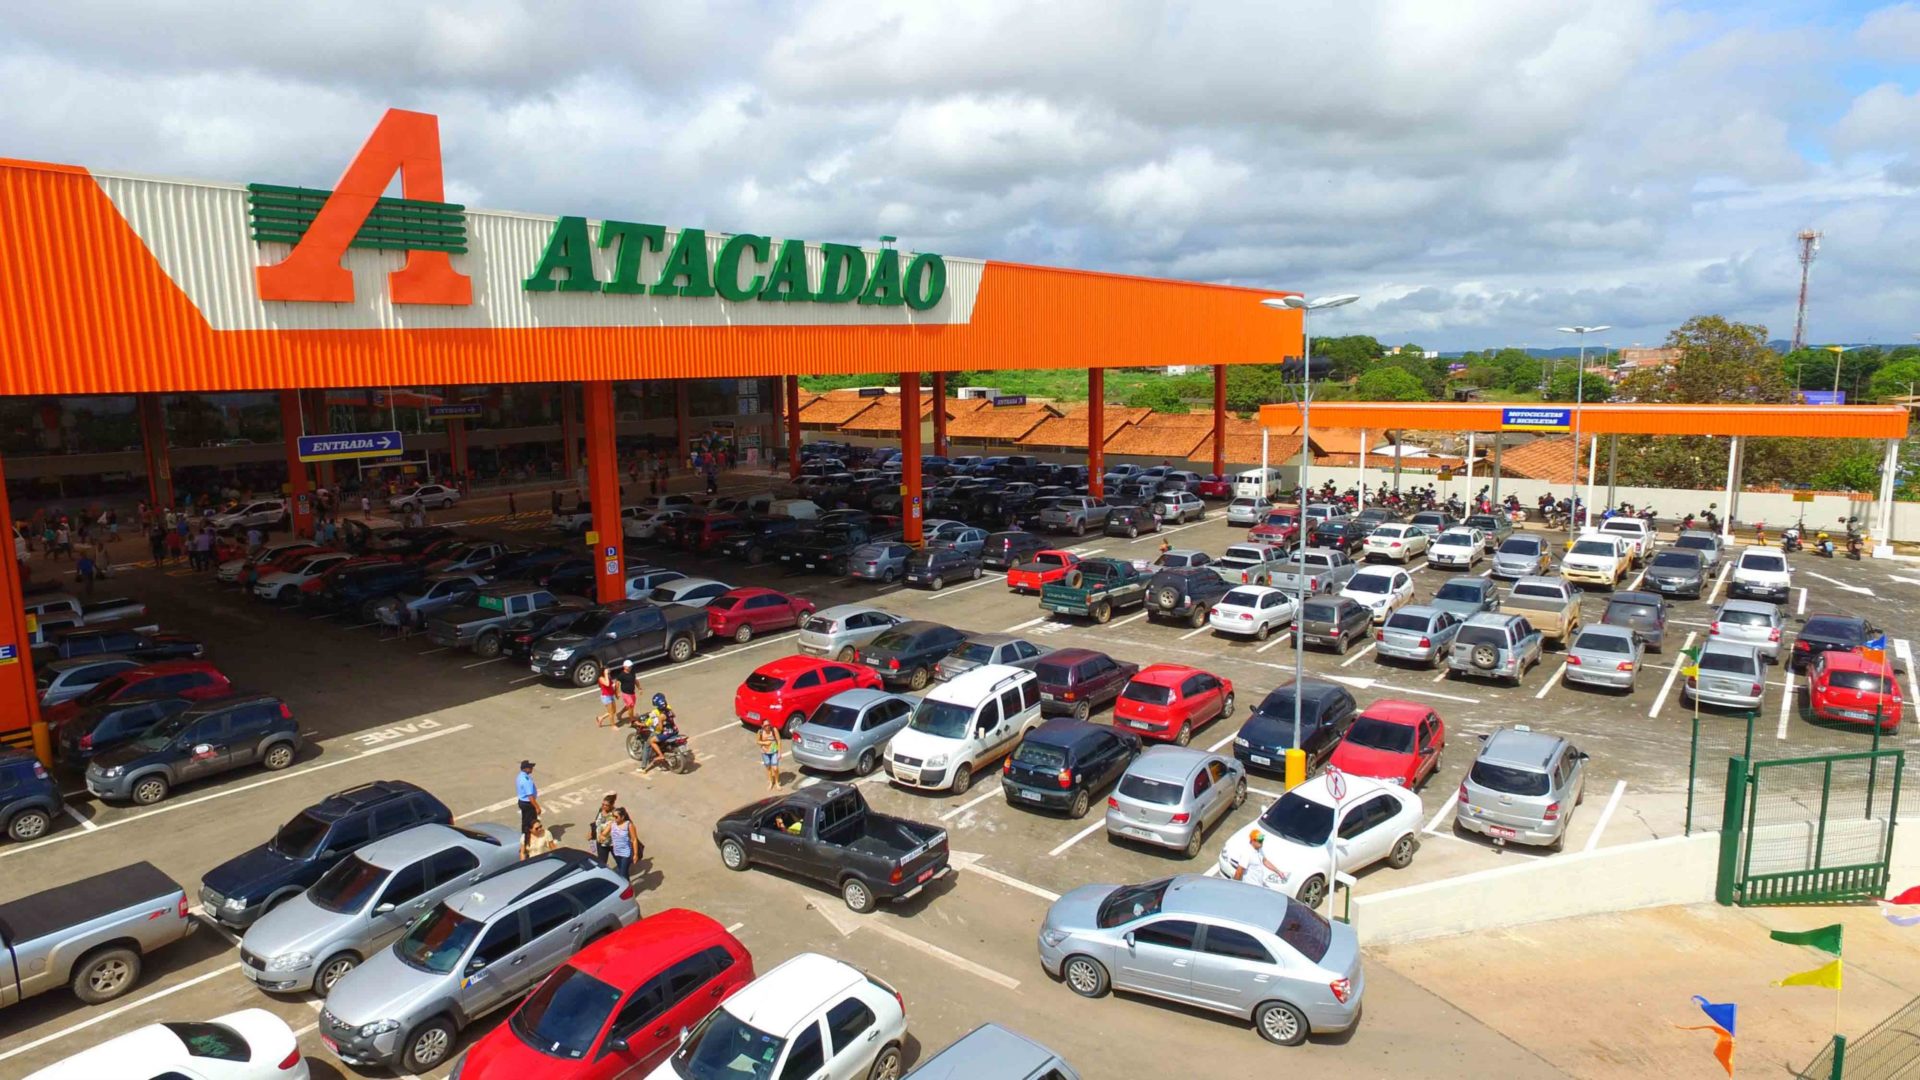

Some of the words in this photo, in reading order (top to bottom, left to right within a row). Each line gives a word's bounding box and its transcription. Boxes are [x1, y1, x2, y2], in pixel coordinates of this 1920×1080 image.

[256, 108, 472, 305] A
[522, 215, 947, 312] ATACADÃO
[312, 438, 375, 452] ENTRADA
[607, 547, 615, 556] D
[352, 718, 443, 746] PARE
